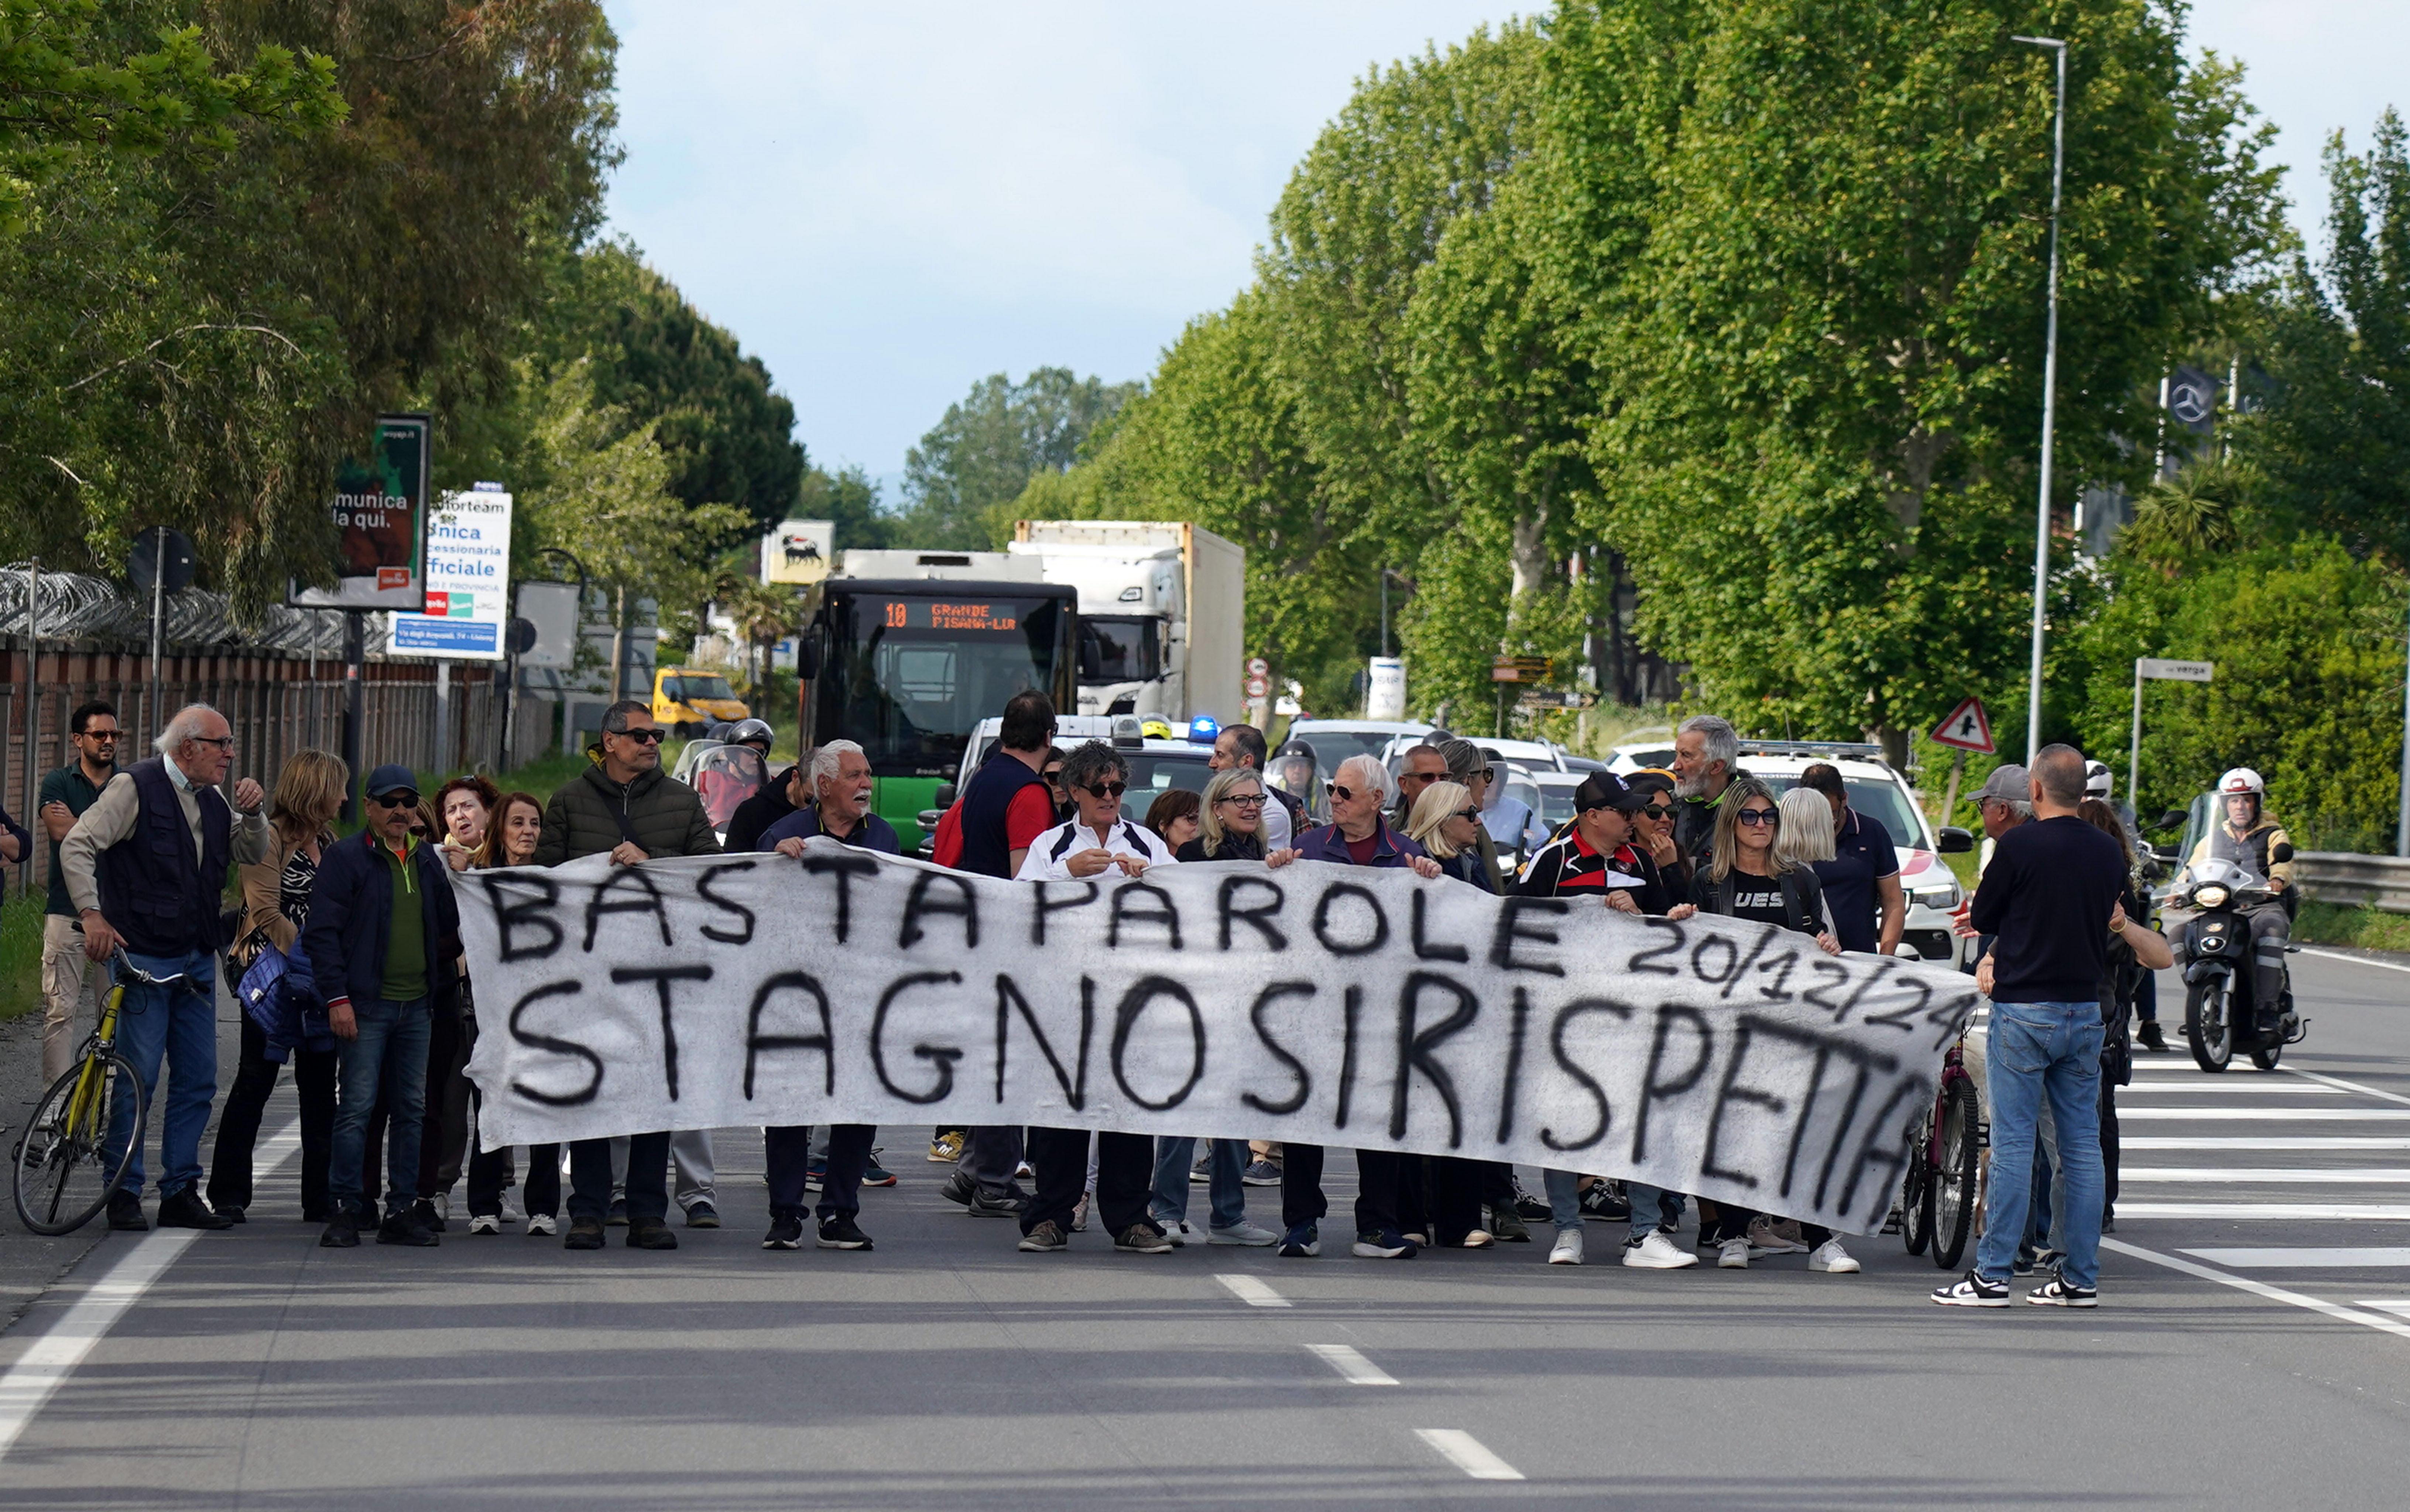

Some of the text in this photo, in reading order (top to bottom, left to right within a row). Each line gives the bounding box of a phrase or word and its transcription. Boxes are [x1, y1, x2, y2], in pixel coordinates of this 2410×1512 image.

[334, 491, 407, 509] munica
[354, 510, 391, 531] qui.
[428, 544, 502, 556] cessionaria
[886, 602, 990, 628] 10 GRANDE
[1734, 892, 1785, 907] UES
[482, 855, 1978, 1052] BASTA PAROLE 20/12/24
[509, 964, 1935, 1229] STAGNO SI RISPETTA
